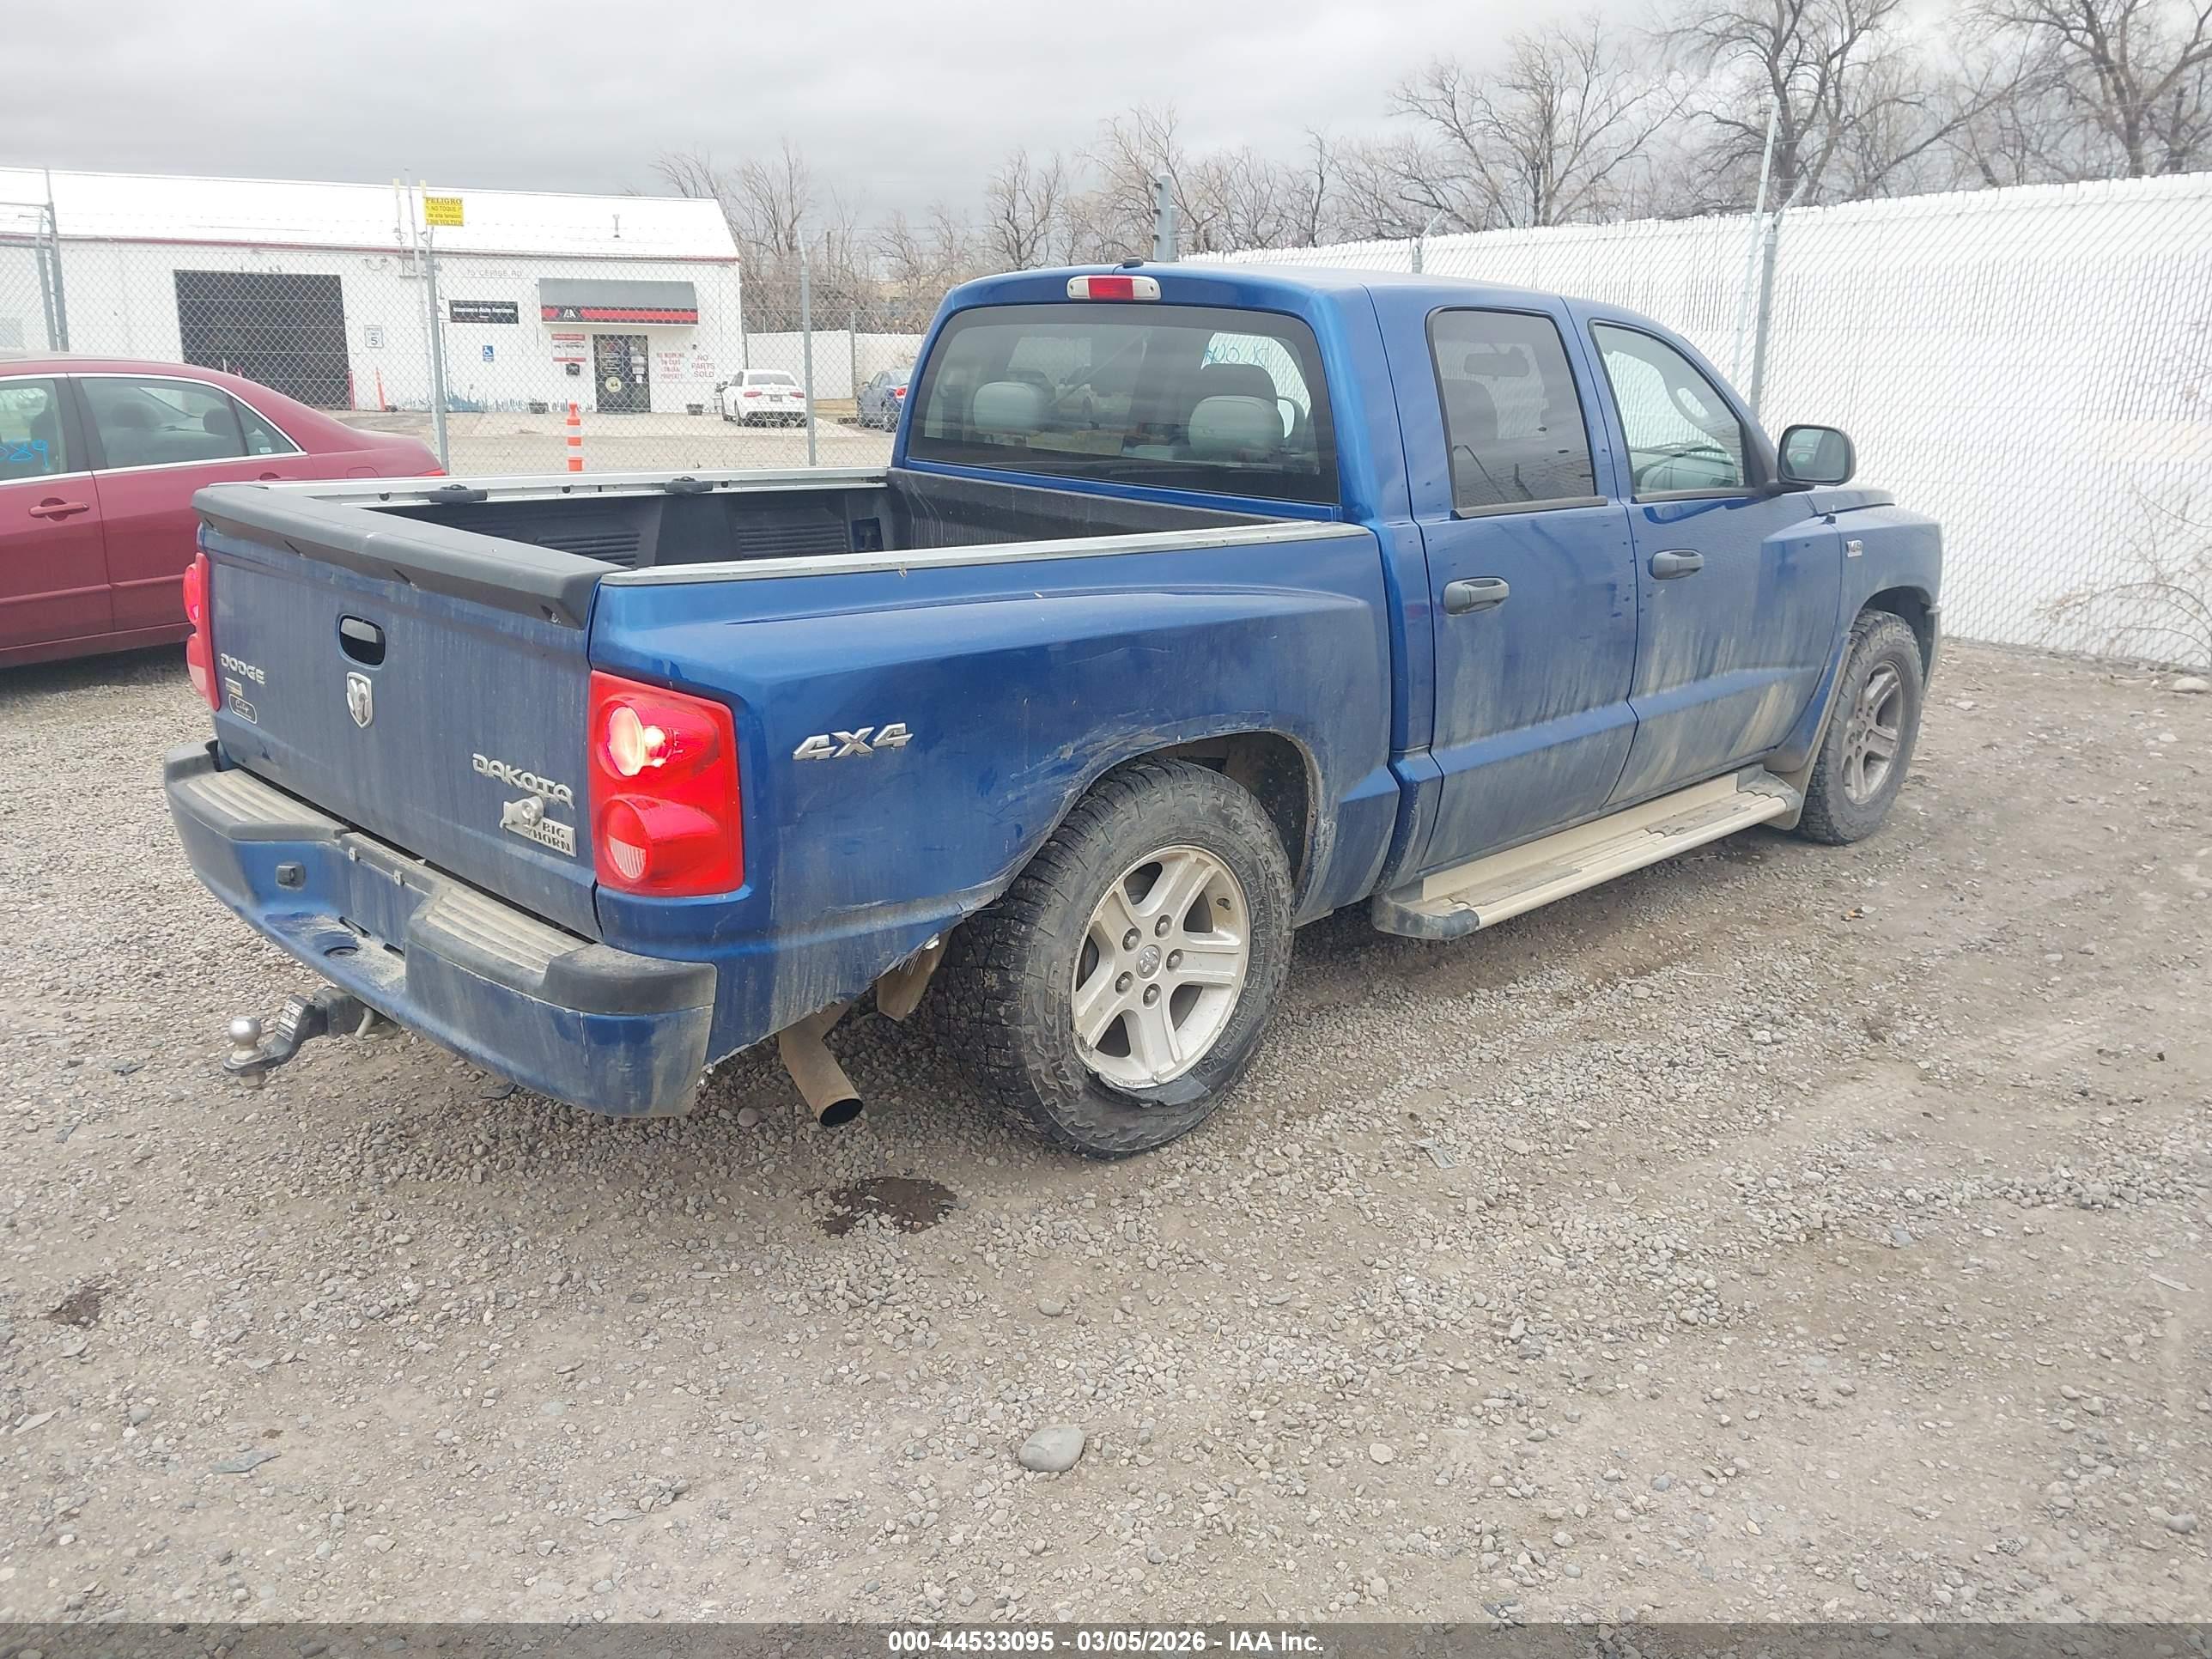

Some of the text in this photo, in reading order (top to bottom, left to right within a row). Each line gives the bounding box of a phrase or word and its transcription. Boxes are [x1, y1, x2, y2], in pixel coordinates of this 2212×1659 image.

[370, 337, 378, 345] 5
[693, 370, 715, 379] SOLD
[220, 653, 265, 685] DODGE
[472, 753, 574, 810] DAKOTA
[542, 822, 565, 838] BIG
[532, 830, 570, 852] HORN
